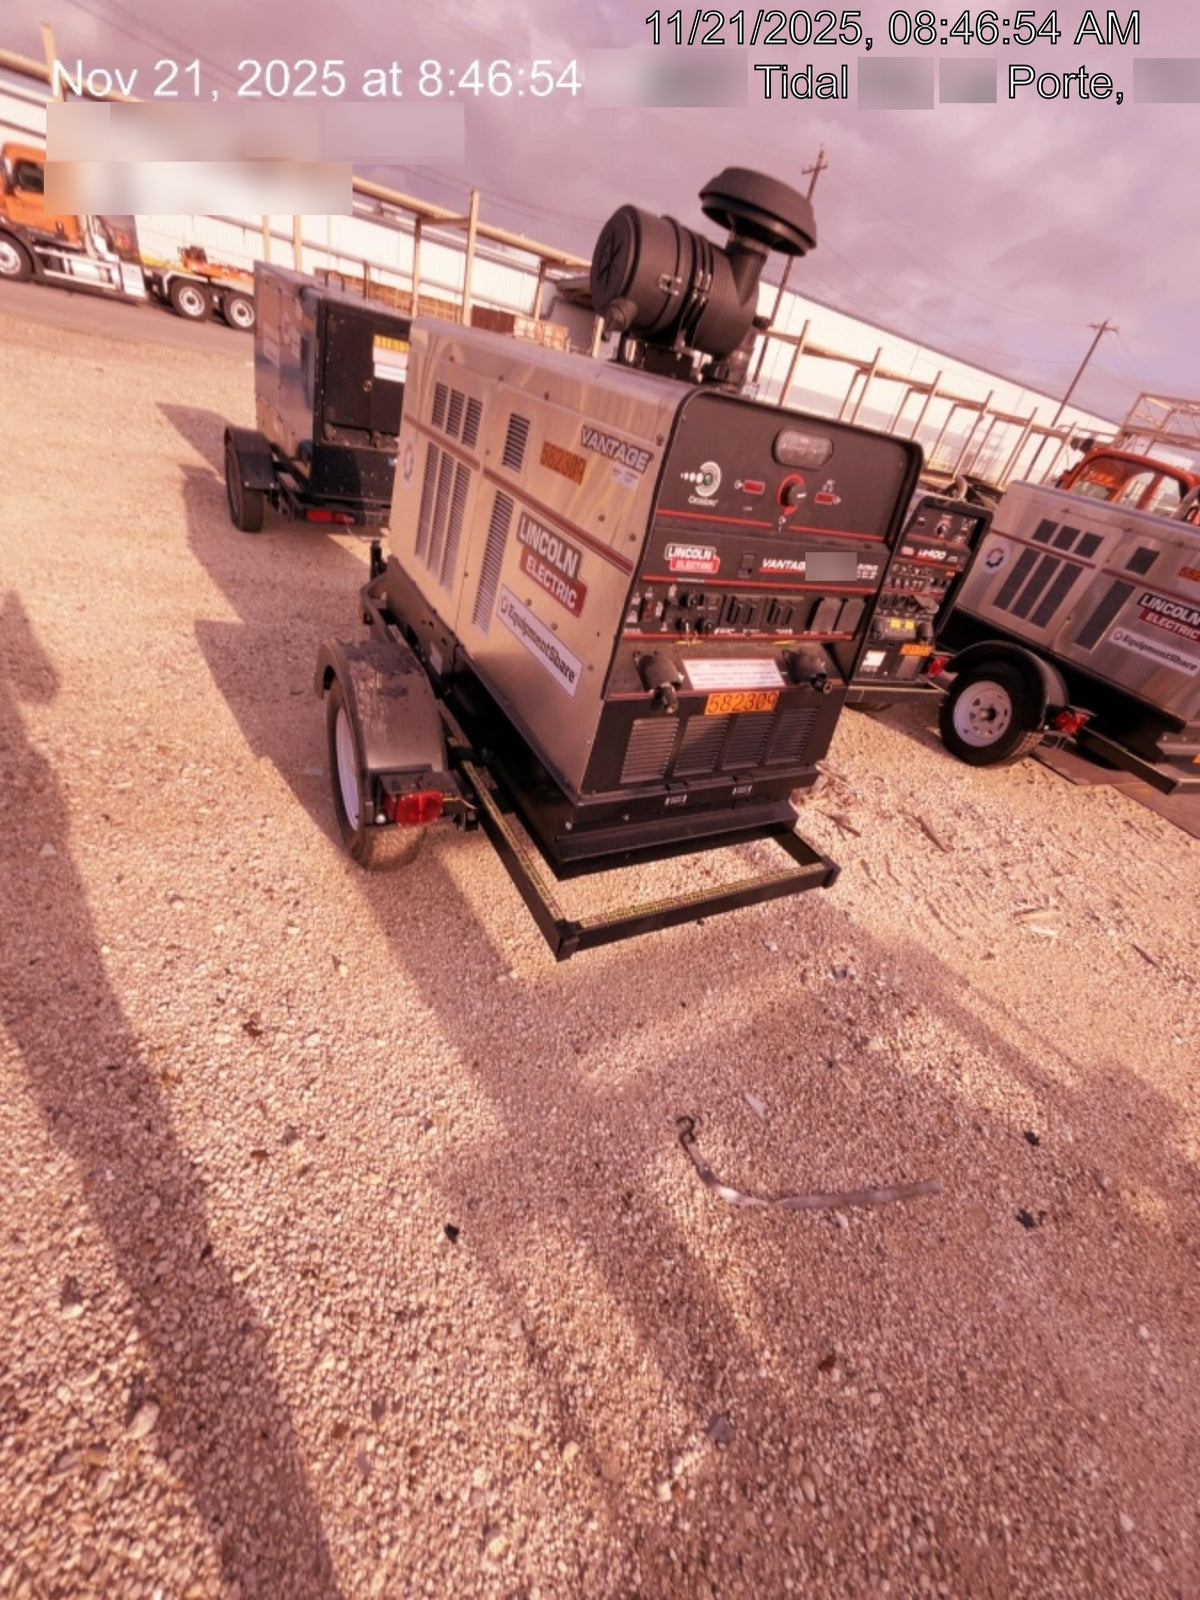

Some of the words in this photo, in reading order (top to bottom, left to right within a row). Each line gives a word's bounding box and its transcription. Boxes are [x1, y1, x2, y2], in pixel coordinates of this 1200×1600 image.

[581, 425, 652, 474] VANTAGE
[519, 517, 578, 579] LINCOLN
[762, 558, 806, 571] VANTAG
[525, 555, 577, 609] ELECTRIC
[1141, 594, 1200, 627] LINCOLN
[1145, 613, 1199, 640] ELECTRIC
[508, 603, 576, 683] EquipmentShare
